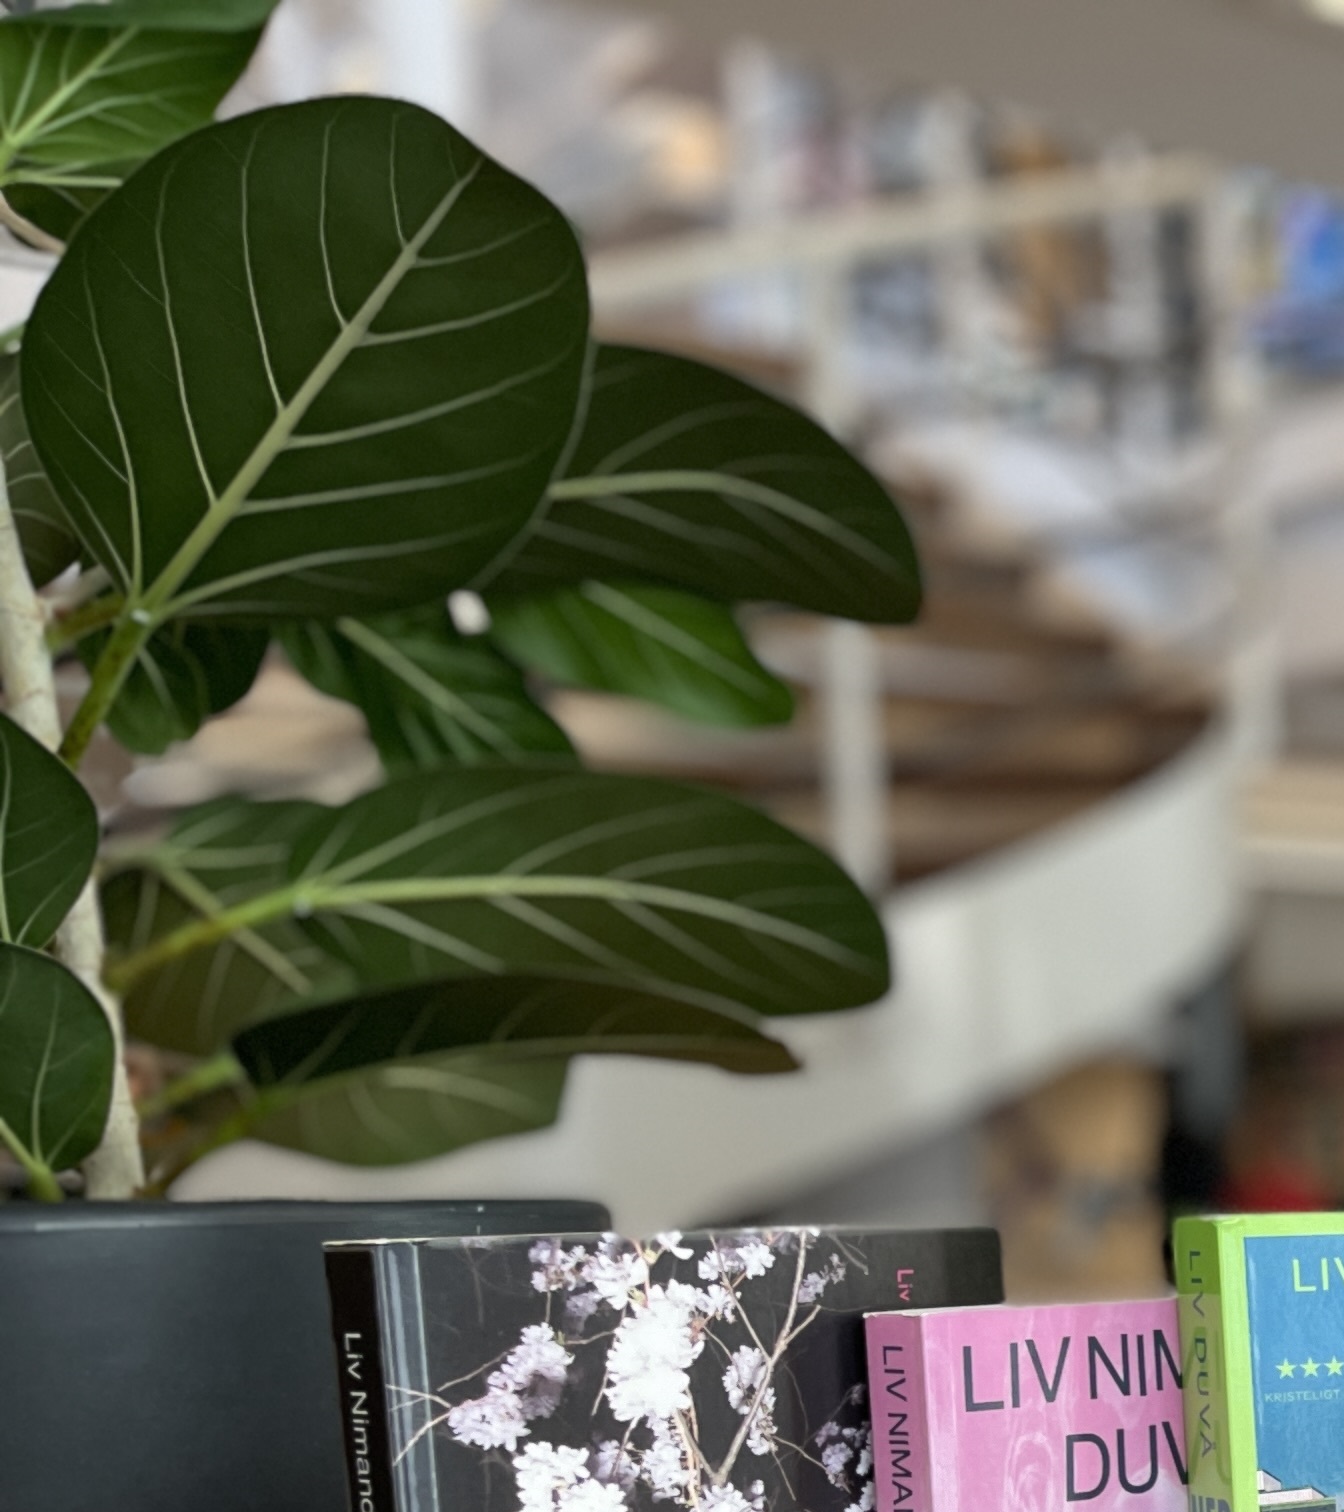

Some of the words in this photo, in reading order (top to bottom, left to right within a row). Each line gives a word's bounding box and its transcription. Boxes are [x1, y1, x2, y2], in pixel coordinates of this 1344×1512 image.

[897, 1269, 914, 1301] Liv
[1189, 1250, 1205, 1317] LIV
[344, 1332, 364, 1379] Liv
[881, 1344, 907, 1402] LIV
[962, 1336, 1071, 1412] LIV
[1194, 1337, 1216, 1458] DUVÅ
[1264, 1388, 1341, 1403] KRISTELIGT
